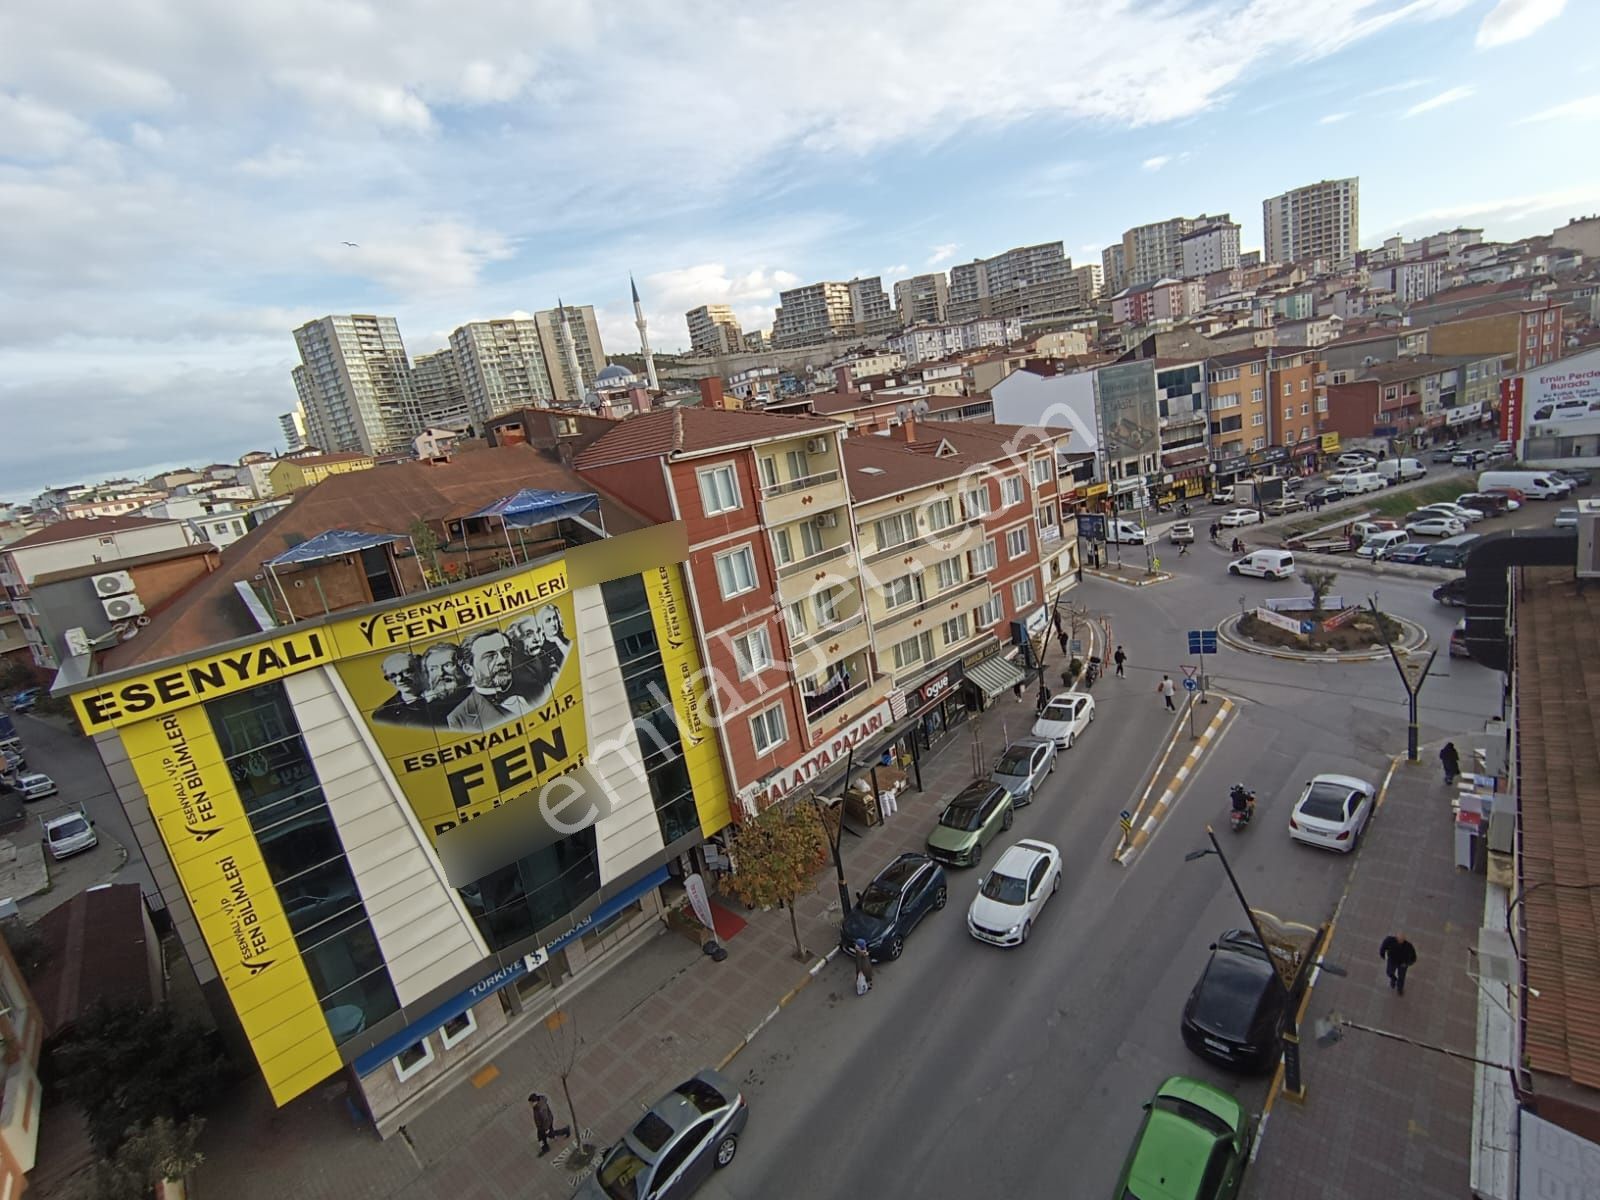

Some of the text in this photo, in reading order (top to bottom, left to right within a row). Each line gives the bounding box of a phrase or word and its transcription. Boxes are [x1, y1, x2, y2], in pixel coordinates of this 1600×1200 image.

[383, 595, 470, 625] ESENYALI
[387, 574, 567, 643] FEN BİLİMLERİ
[659, 566, 681, 637] FEN BİLİMLER
[82, 634, 325, 725] ESENYALI
[919, 671, 948, 702] Vogue
[156, 713, 216, 823] FEN BİLİMLERİ
[403, 722, 523, 773] ESENYALI
[538, 694, 576, 722] V.İ.P.
[446, 726, 569, 809] FEN
[753, 711, 883, 807] MALATYA PAZARI
[173, 782, 198, 826] ESENYALI
[215, 855, 270, 956] FEN BİLİMLERİ
[469, 960, 523, 997] TÜRKİYE
